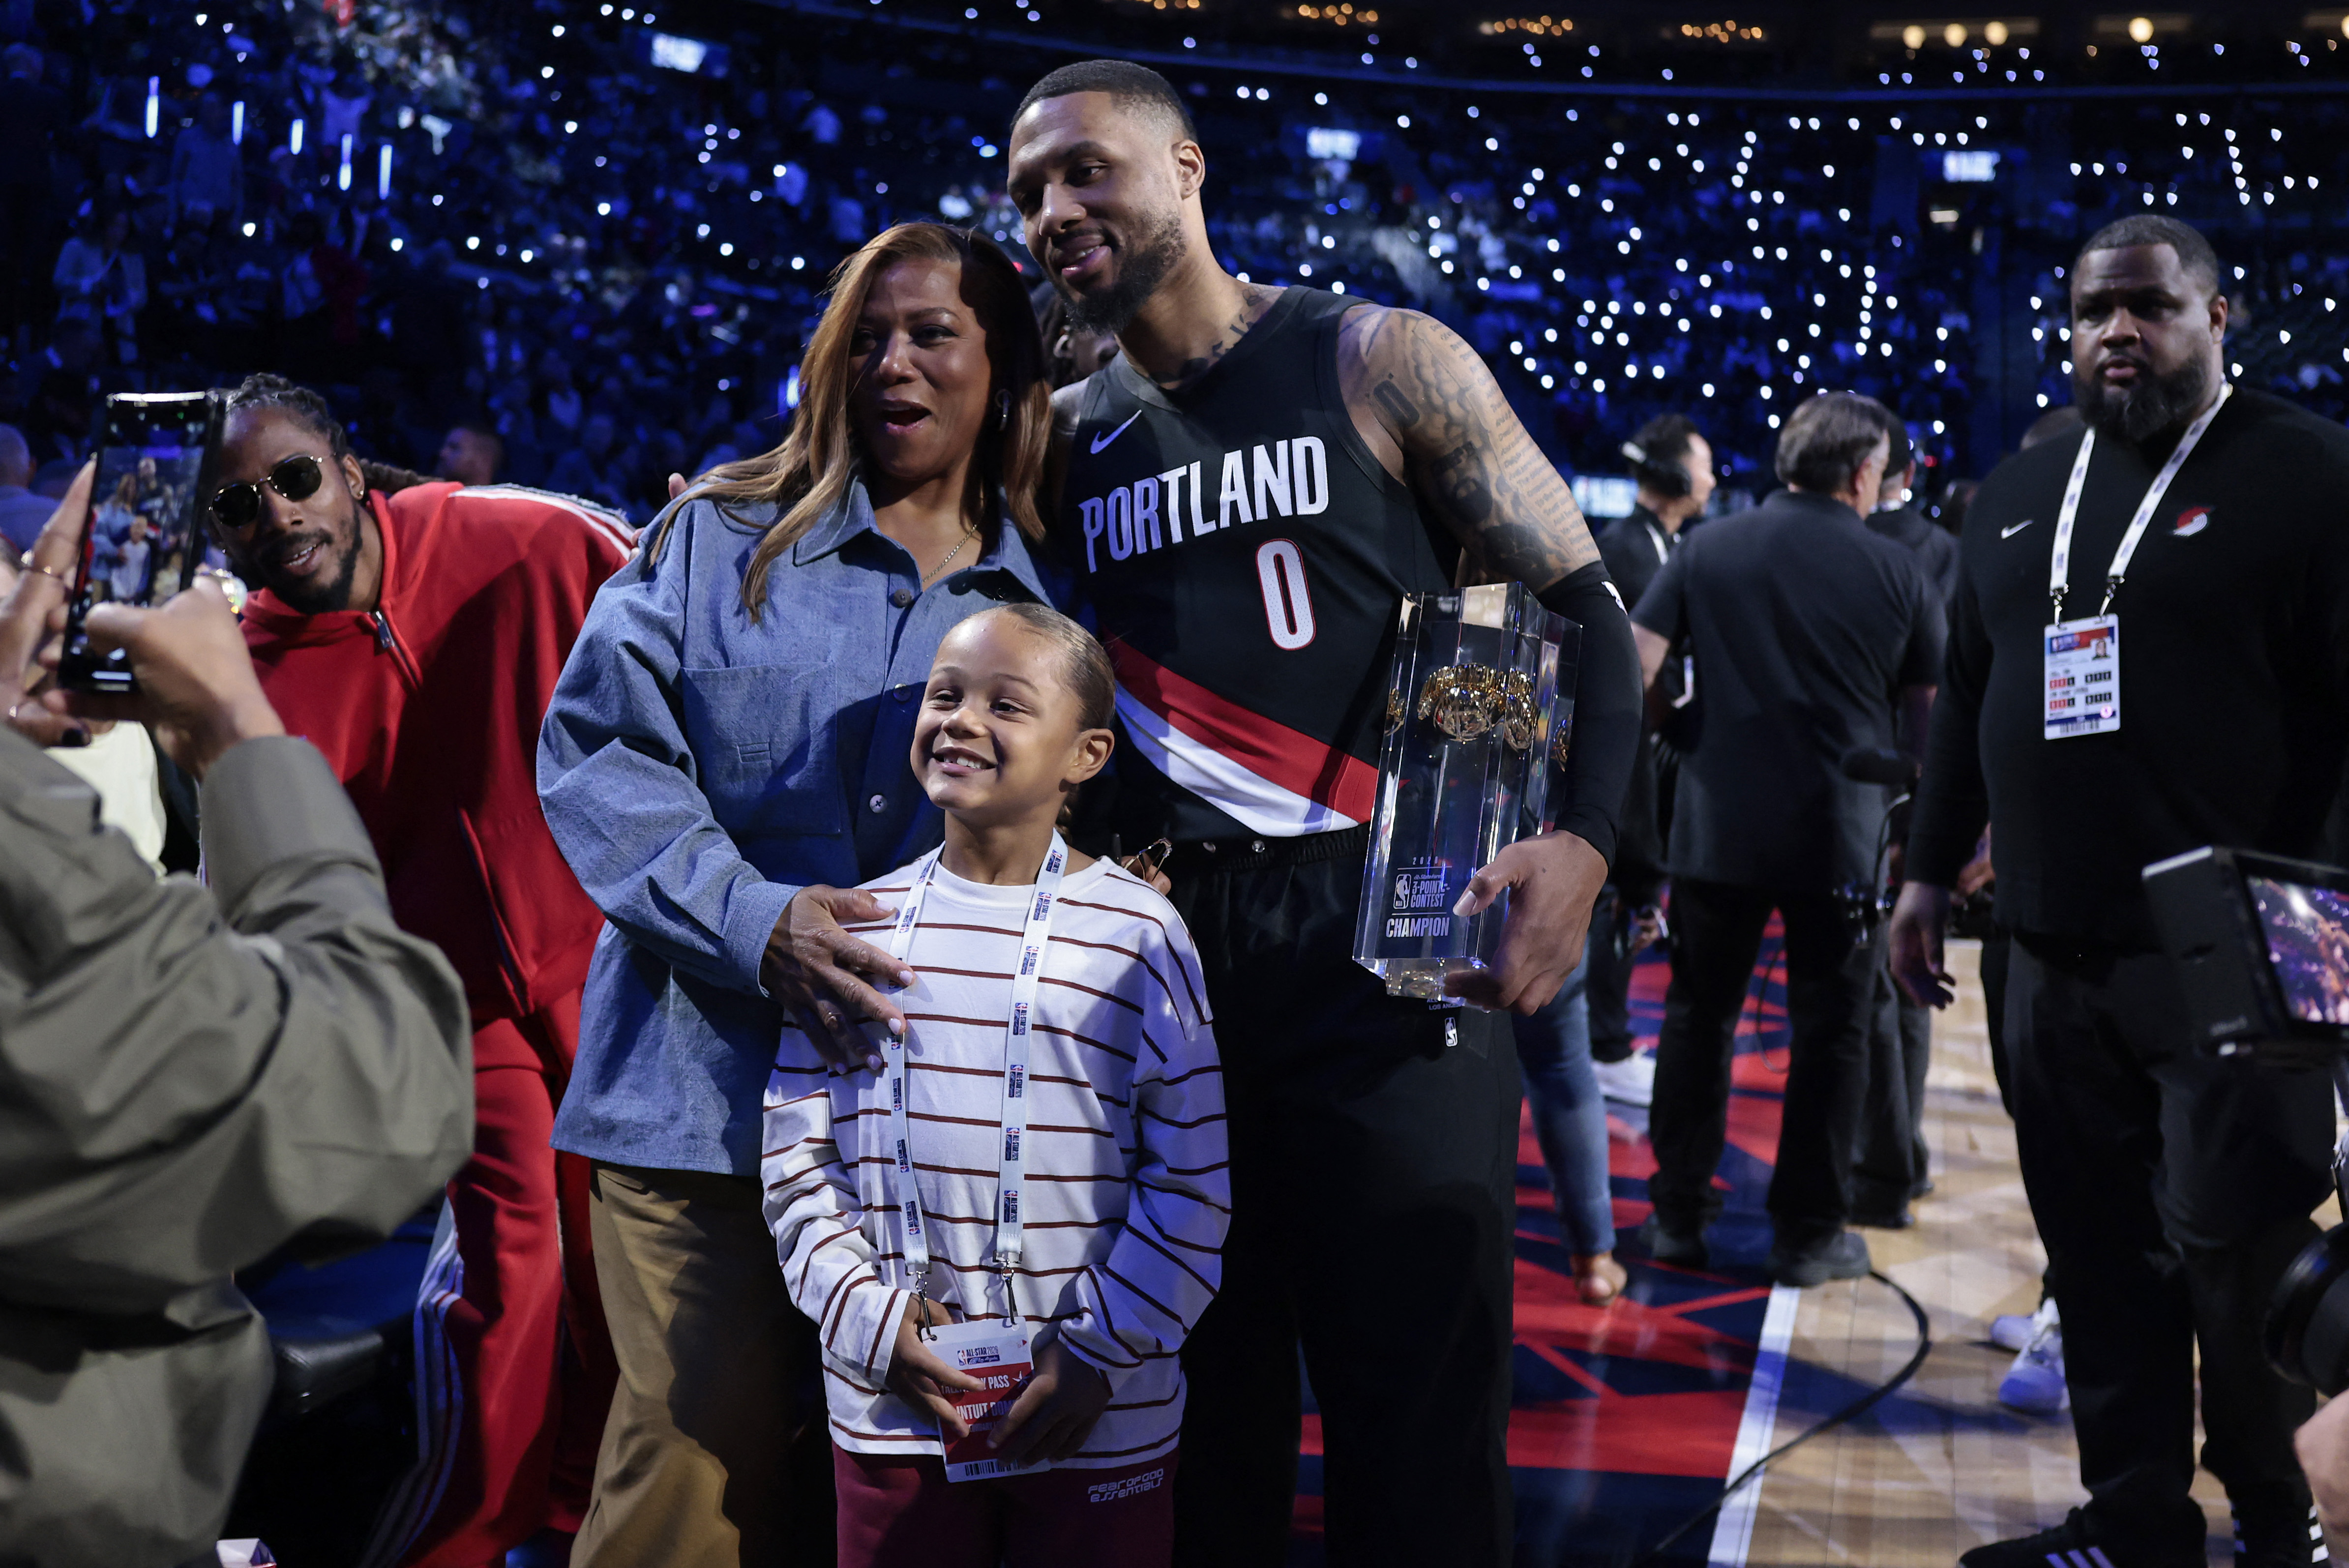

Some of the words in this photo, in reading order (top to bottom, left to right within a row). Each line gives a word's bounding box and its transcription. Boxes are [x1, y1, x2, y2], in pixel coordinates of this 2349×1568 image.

[1078, 436, 1329, 573] PORTLAND
[1255, 538, 1316, 651] 0
[1410, 893, 1445, 908] CONTEST
[1386, 917, 1450, 938] CHAMPION
[966, 1347, 987, 1357] ALL-STAR
[988, 1375, 1010, 1390] PASS
